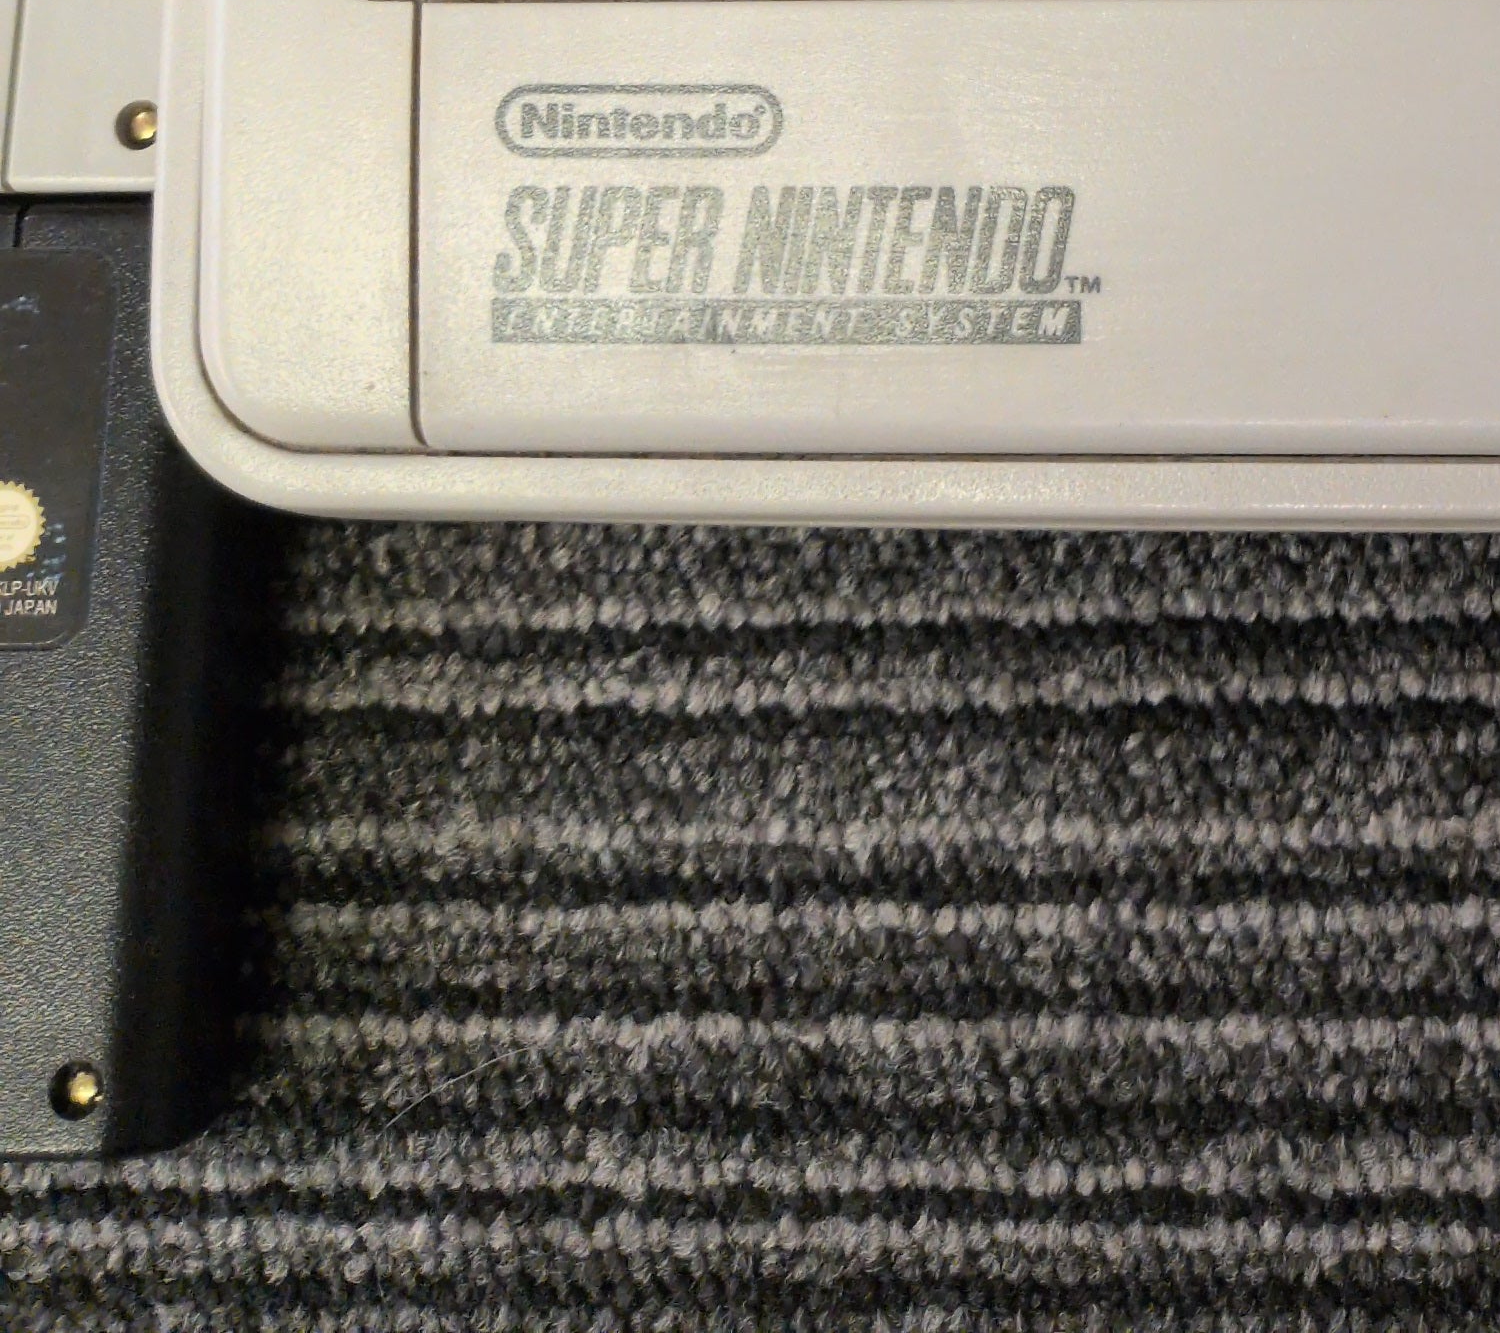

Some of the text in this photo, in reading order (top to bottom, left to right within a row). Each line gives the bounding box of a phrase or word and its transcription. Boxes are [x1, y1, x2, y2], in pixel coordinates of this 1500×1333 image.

[492, 184, 725, 294] SUPER
[733, 185, 1075, 294] NINTENDO
[894, 305, 1073, 336] SYSTEM
[5, 600, 57, 615] JAPAN
